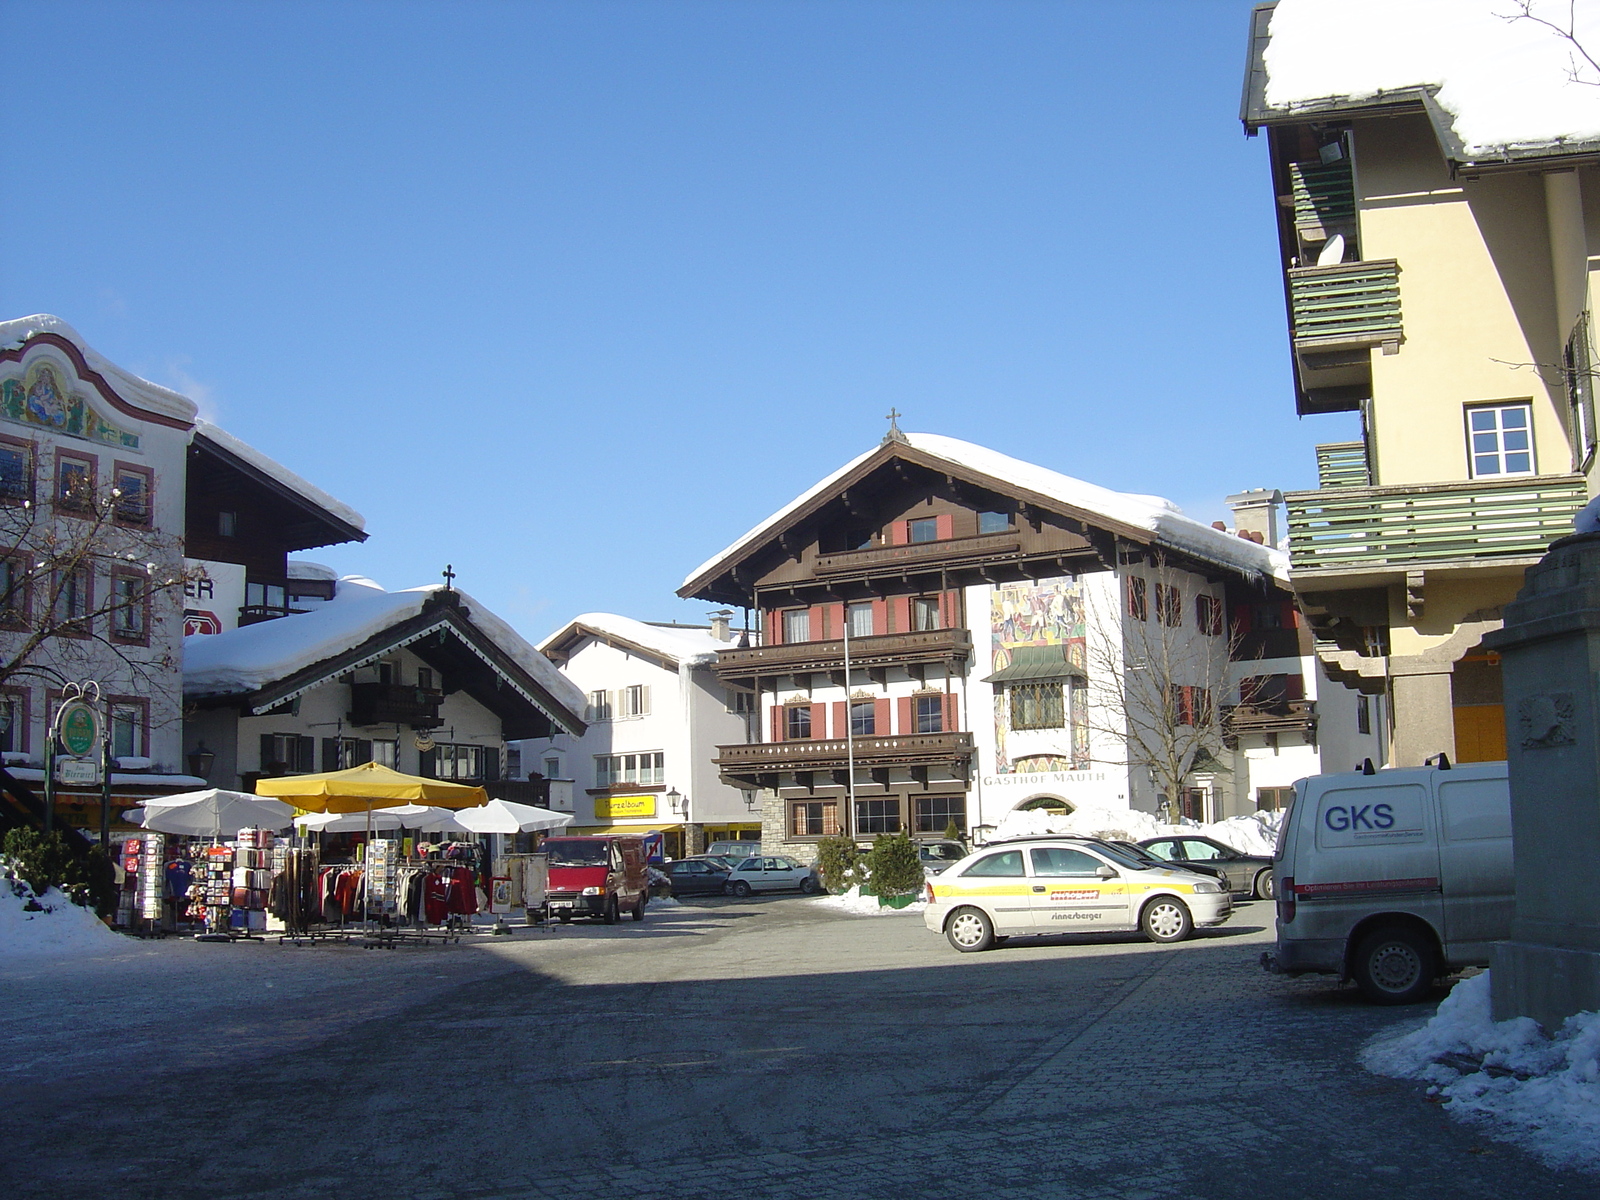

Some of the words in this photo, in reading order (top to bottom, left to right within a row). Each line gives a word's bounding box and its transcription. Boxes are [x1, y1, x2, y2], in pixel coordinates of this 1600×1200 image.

[983, 774, 1047, 786] GASTHOF
[1053, 772, 1106, 783] MAUTH
[604, 800, 646, 809] Purzelbaum
[1325, 803, 1395, 831] GKS
[1051, 912, 1102, 921] sinnesberger
